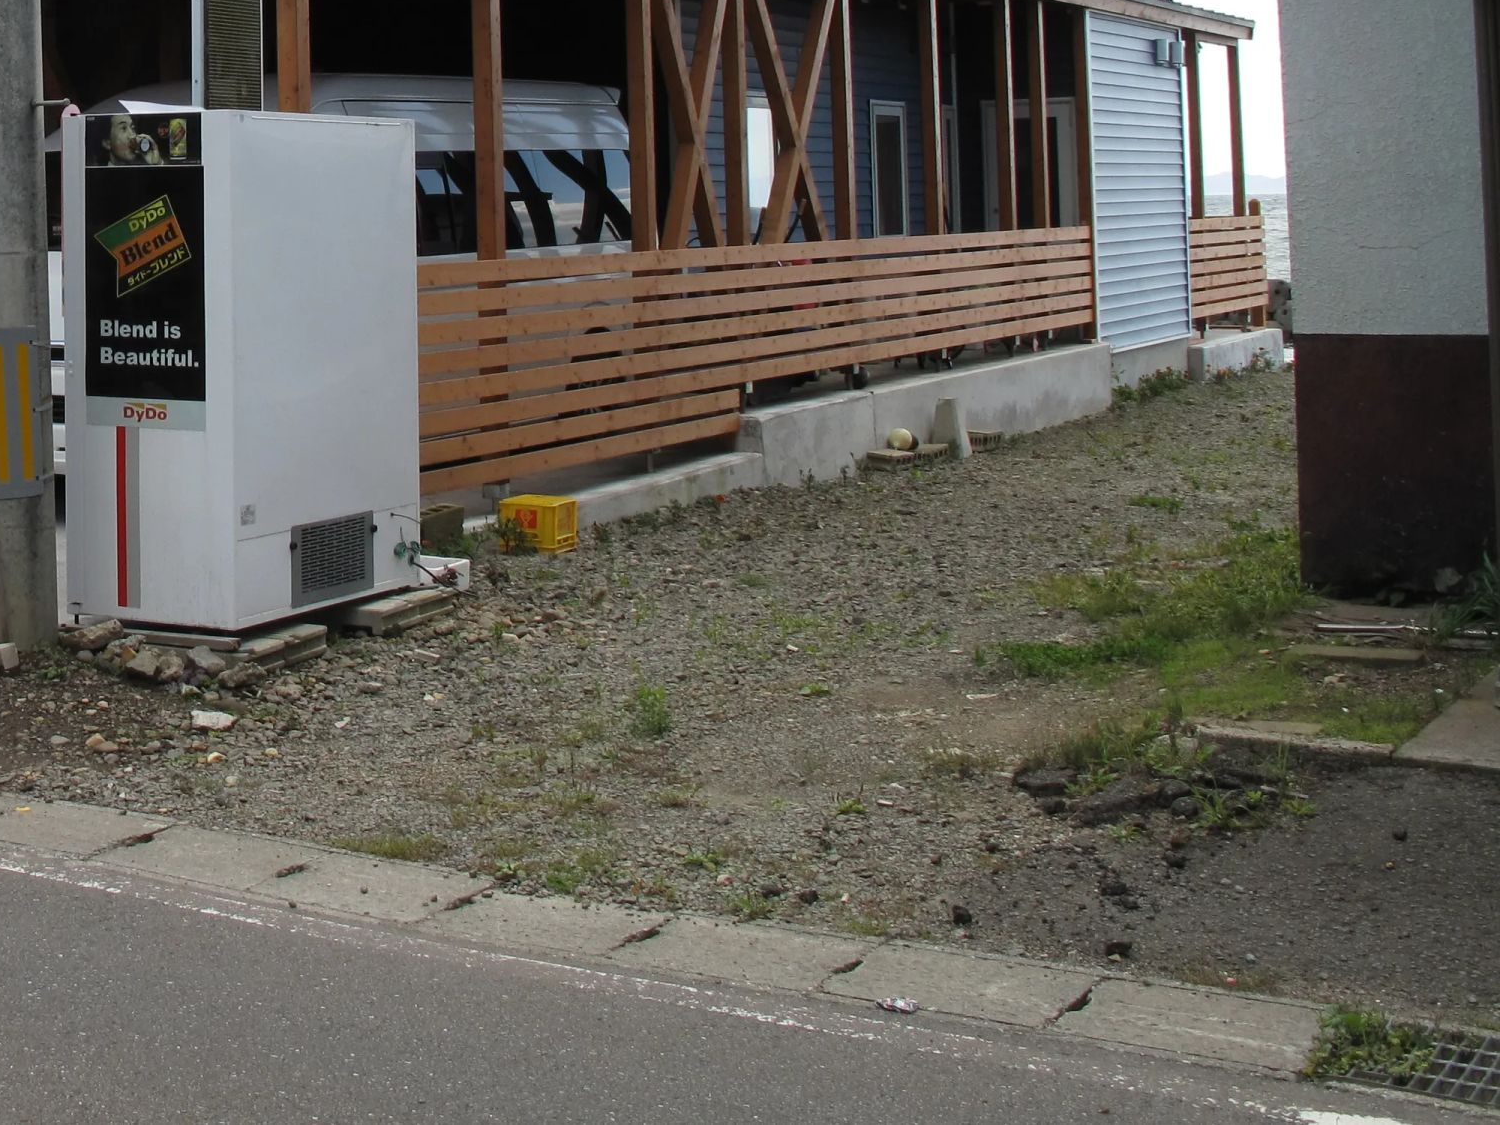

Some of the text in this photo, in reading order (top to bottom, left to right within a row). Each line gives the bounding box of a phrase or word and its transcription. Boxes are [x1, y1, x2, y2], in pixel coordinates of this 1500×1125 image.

[128, 203, 166, 232] DyDo
[120, 222, 177, 266] Blend
[127, 246, 187, 286] ダイドーブレンド
[100, 319, 181, 339] Blend is
[100, 347, 199, 368] Beautiful.
[123, 404, 168, 422] DyDo
